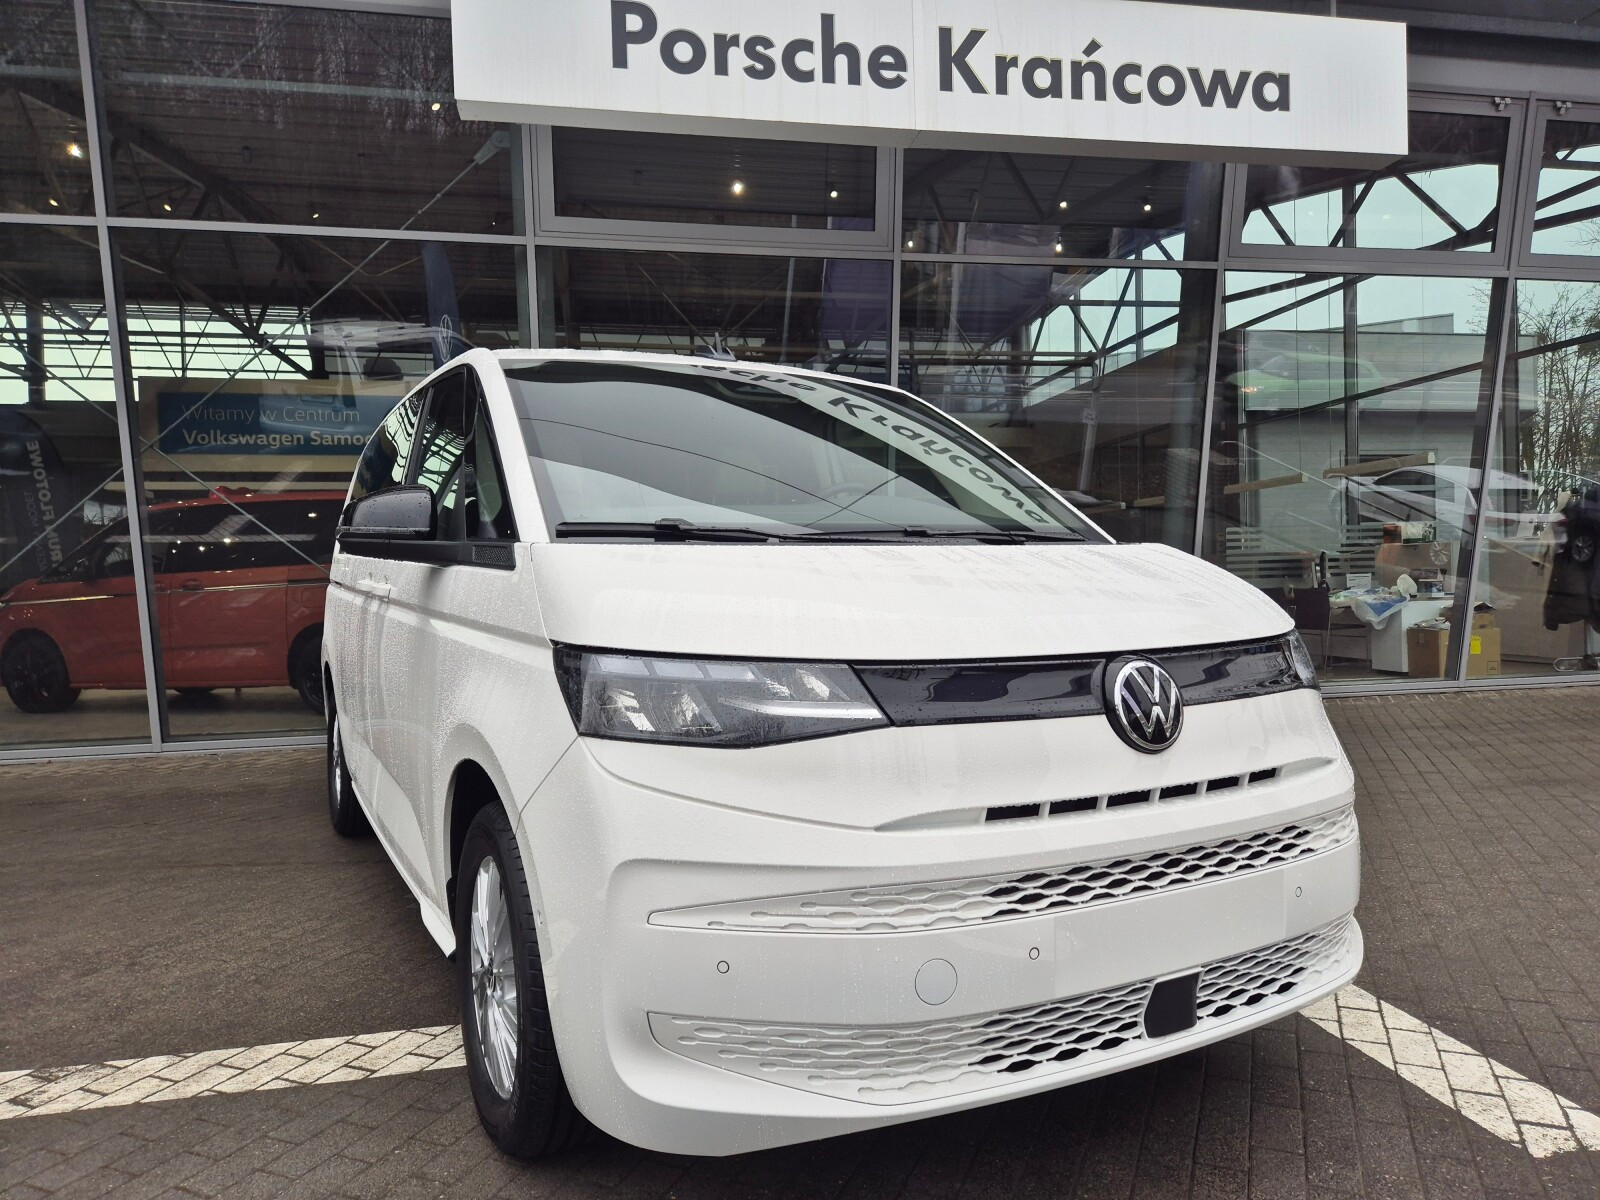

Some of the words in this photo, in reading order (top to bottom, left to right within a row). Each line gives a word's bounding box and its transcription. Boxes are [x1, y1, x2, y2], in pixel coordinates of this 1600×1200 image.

[610, 0, 908, 89] Porsche
[938, 26, 1290, 112] Krańcowa
[181, 405, 255, 425] Witamy
[260, 410, 277, 421] w
[283, 406, 360, 422] Centrum
[182, 428, 304, 447] Volkswagen
